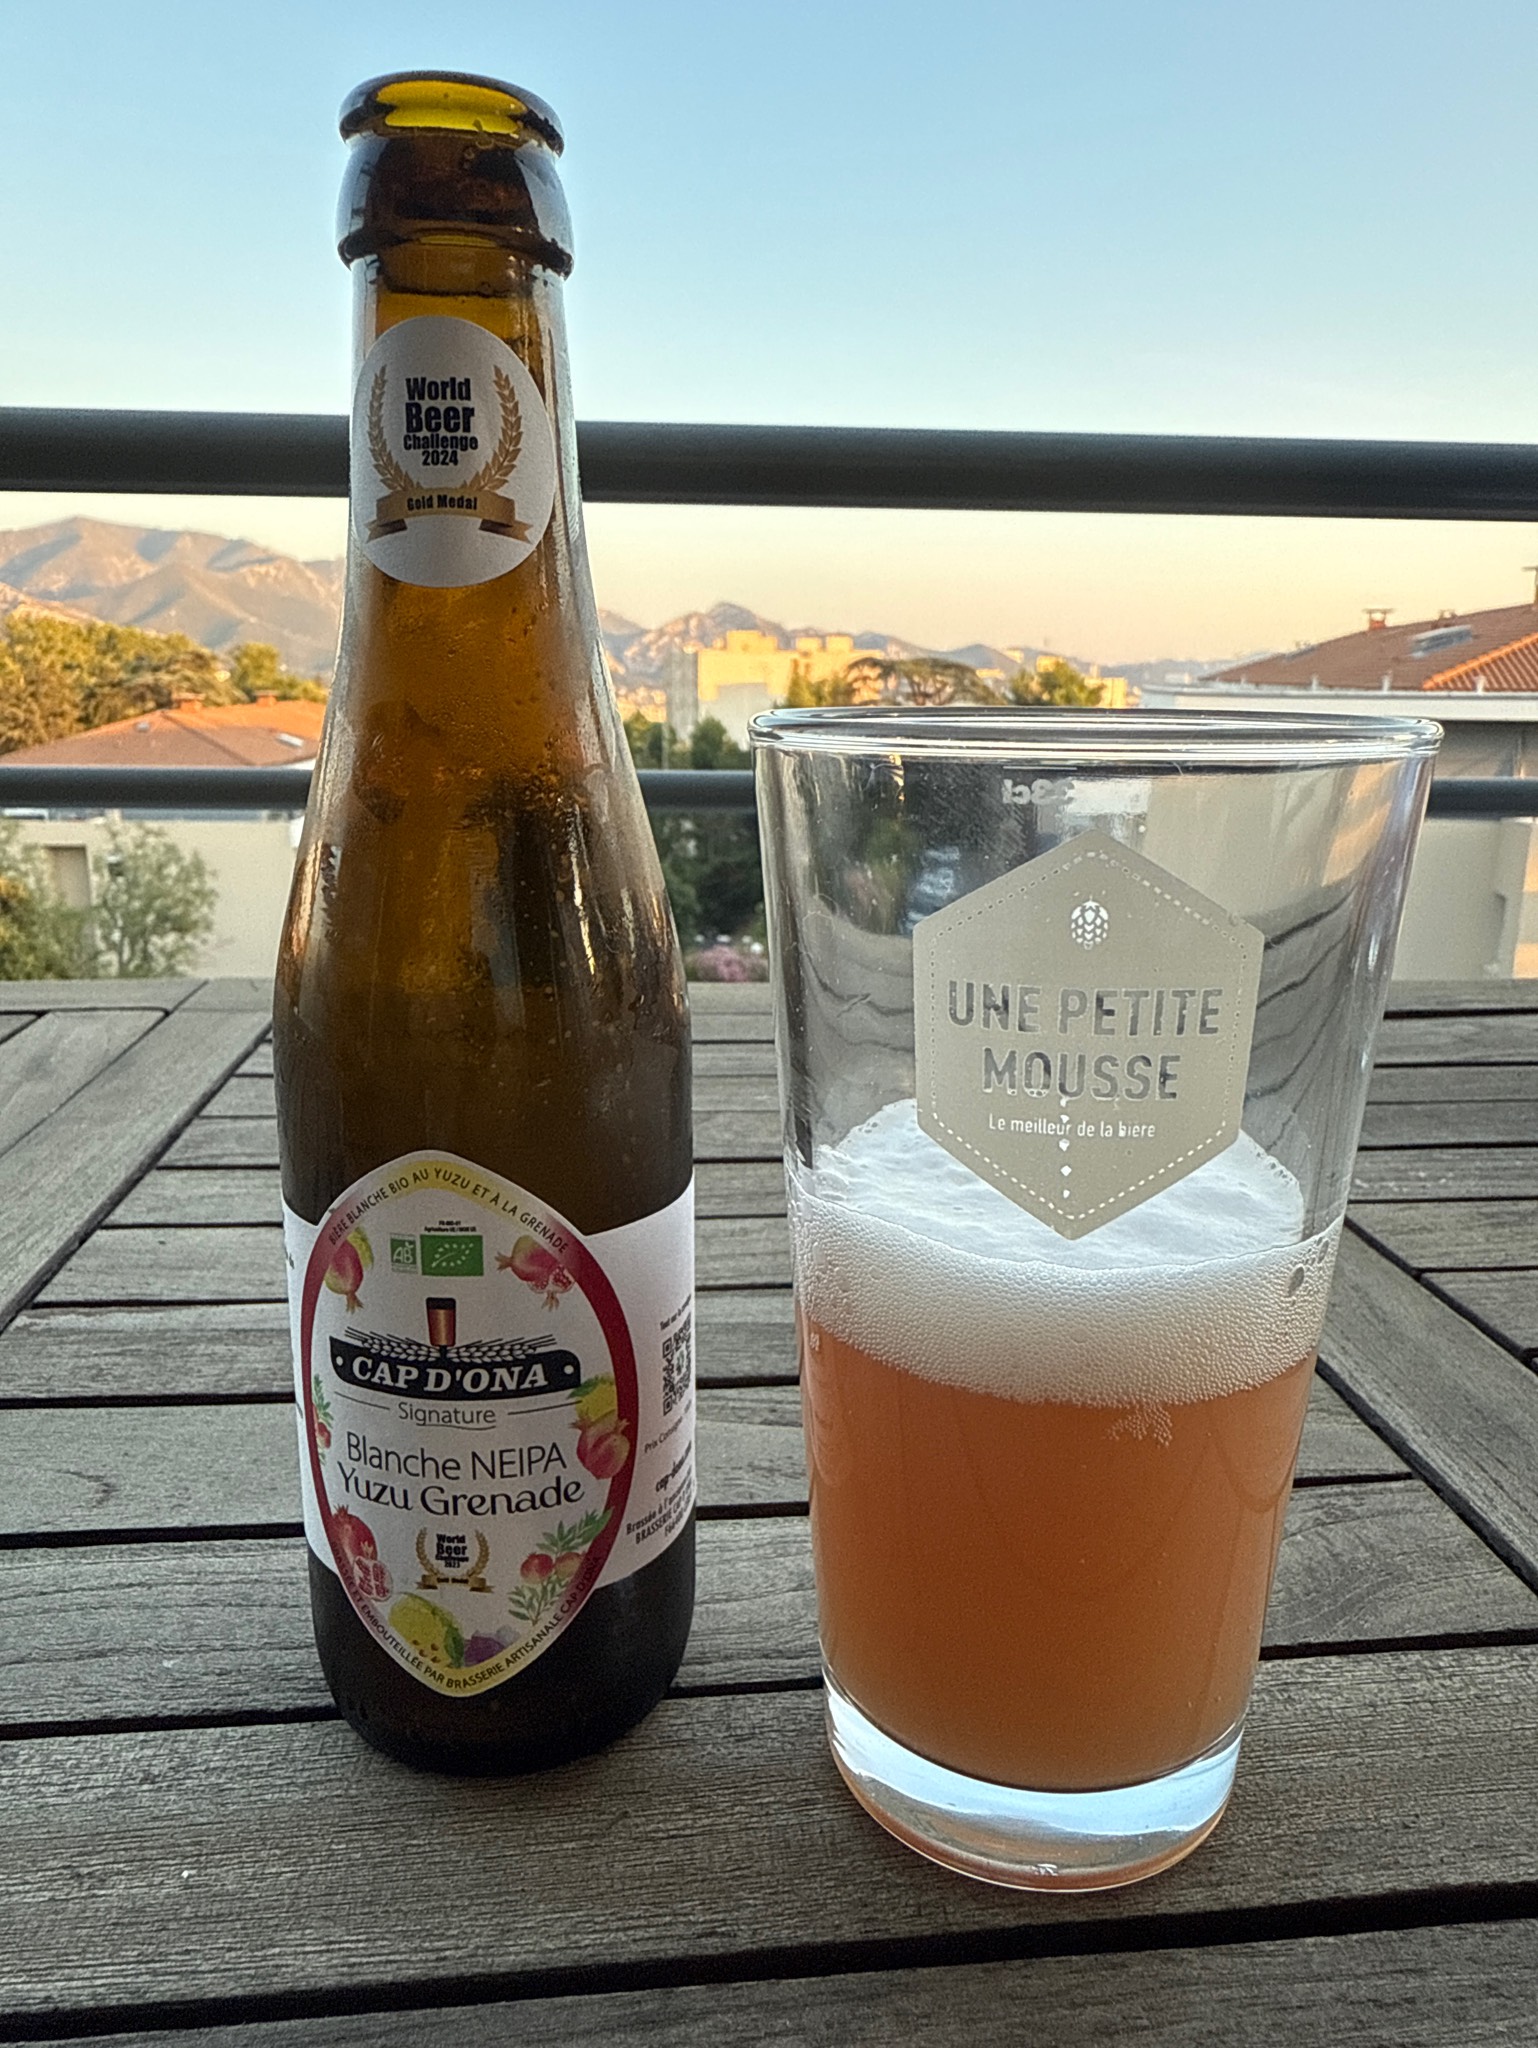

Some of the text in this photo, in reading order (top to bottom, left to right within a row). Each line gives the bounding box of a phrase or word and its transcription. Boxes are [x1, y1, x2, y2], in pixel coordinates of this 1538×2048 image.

[405, 377, 471, 401] World
[405, 402, 475, 433] Beer
[403, 433, 478, 451] Challenge
[422, 450, 459, 466] 2024
[407, 494, 478, 511] Gold Medal
[948, 980, 1223, 1036] UNE PETITE
[983, 1047, 1181, 1099] MOUSSE
[989, 1113, 1006, 1131] Le
[1010, 1117, 1071, 1136] meilleur
[1077, 1120, 1095, 1137] de
[1100, 1120, 1113, 1137] la
[346, 1187, 389, 1225] BLANCHE
[388, 1177, 409, 1194] BIO
[412, 1168, 429, 1184] AU
[434, 1167, 471, 1189] YUZU
[472, 1184, 490, 1198] ET
[502, 1200, 518, 1217] LA
[520, 1212, 569, 1253] GRENADE
[352, 1356, 548, 1393] CAP D'ONA
[398, 1402, 496, 1427] Signature
[347, 1431, 567, 1480] Blanche NEIPA
[337, 1461, 586, 1516] Yuzu Grenade
[436, 1533, 466, 1544] World
[436, 1542, 468, 1556] Beer
[424, 1666, 445, 1684] PAR
[446, 1663, 505, 1689] BRASSERIE
[505, 1614, 562, 1667] ARTISANALE
[560, 1593, 578, 1614] CAP
